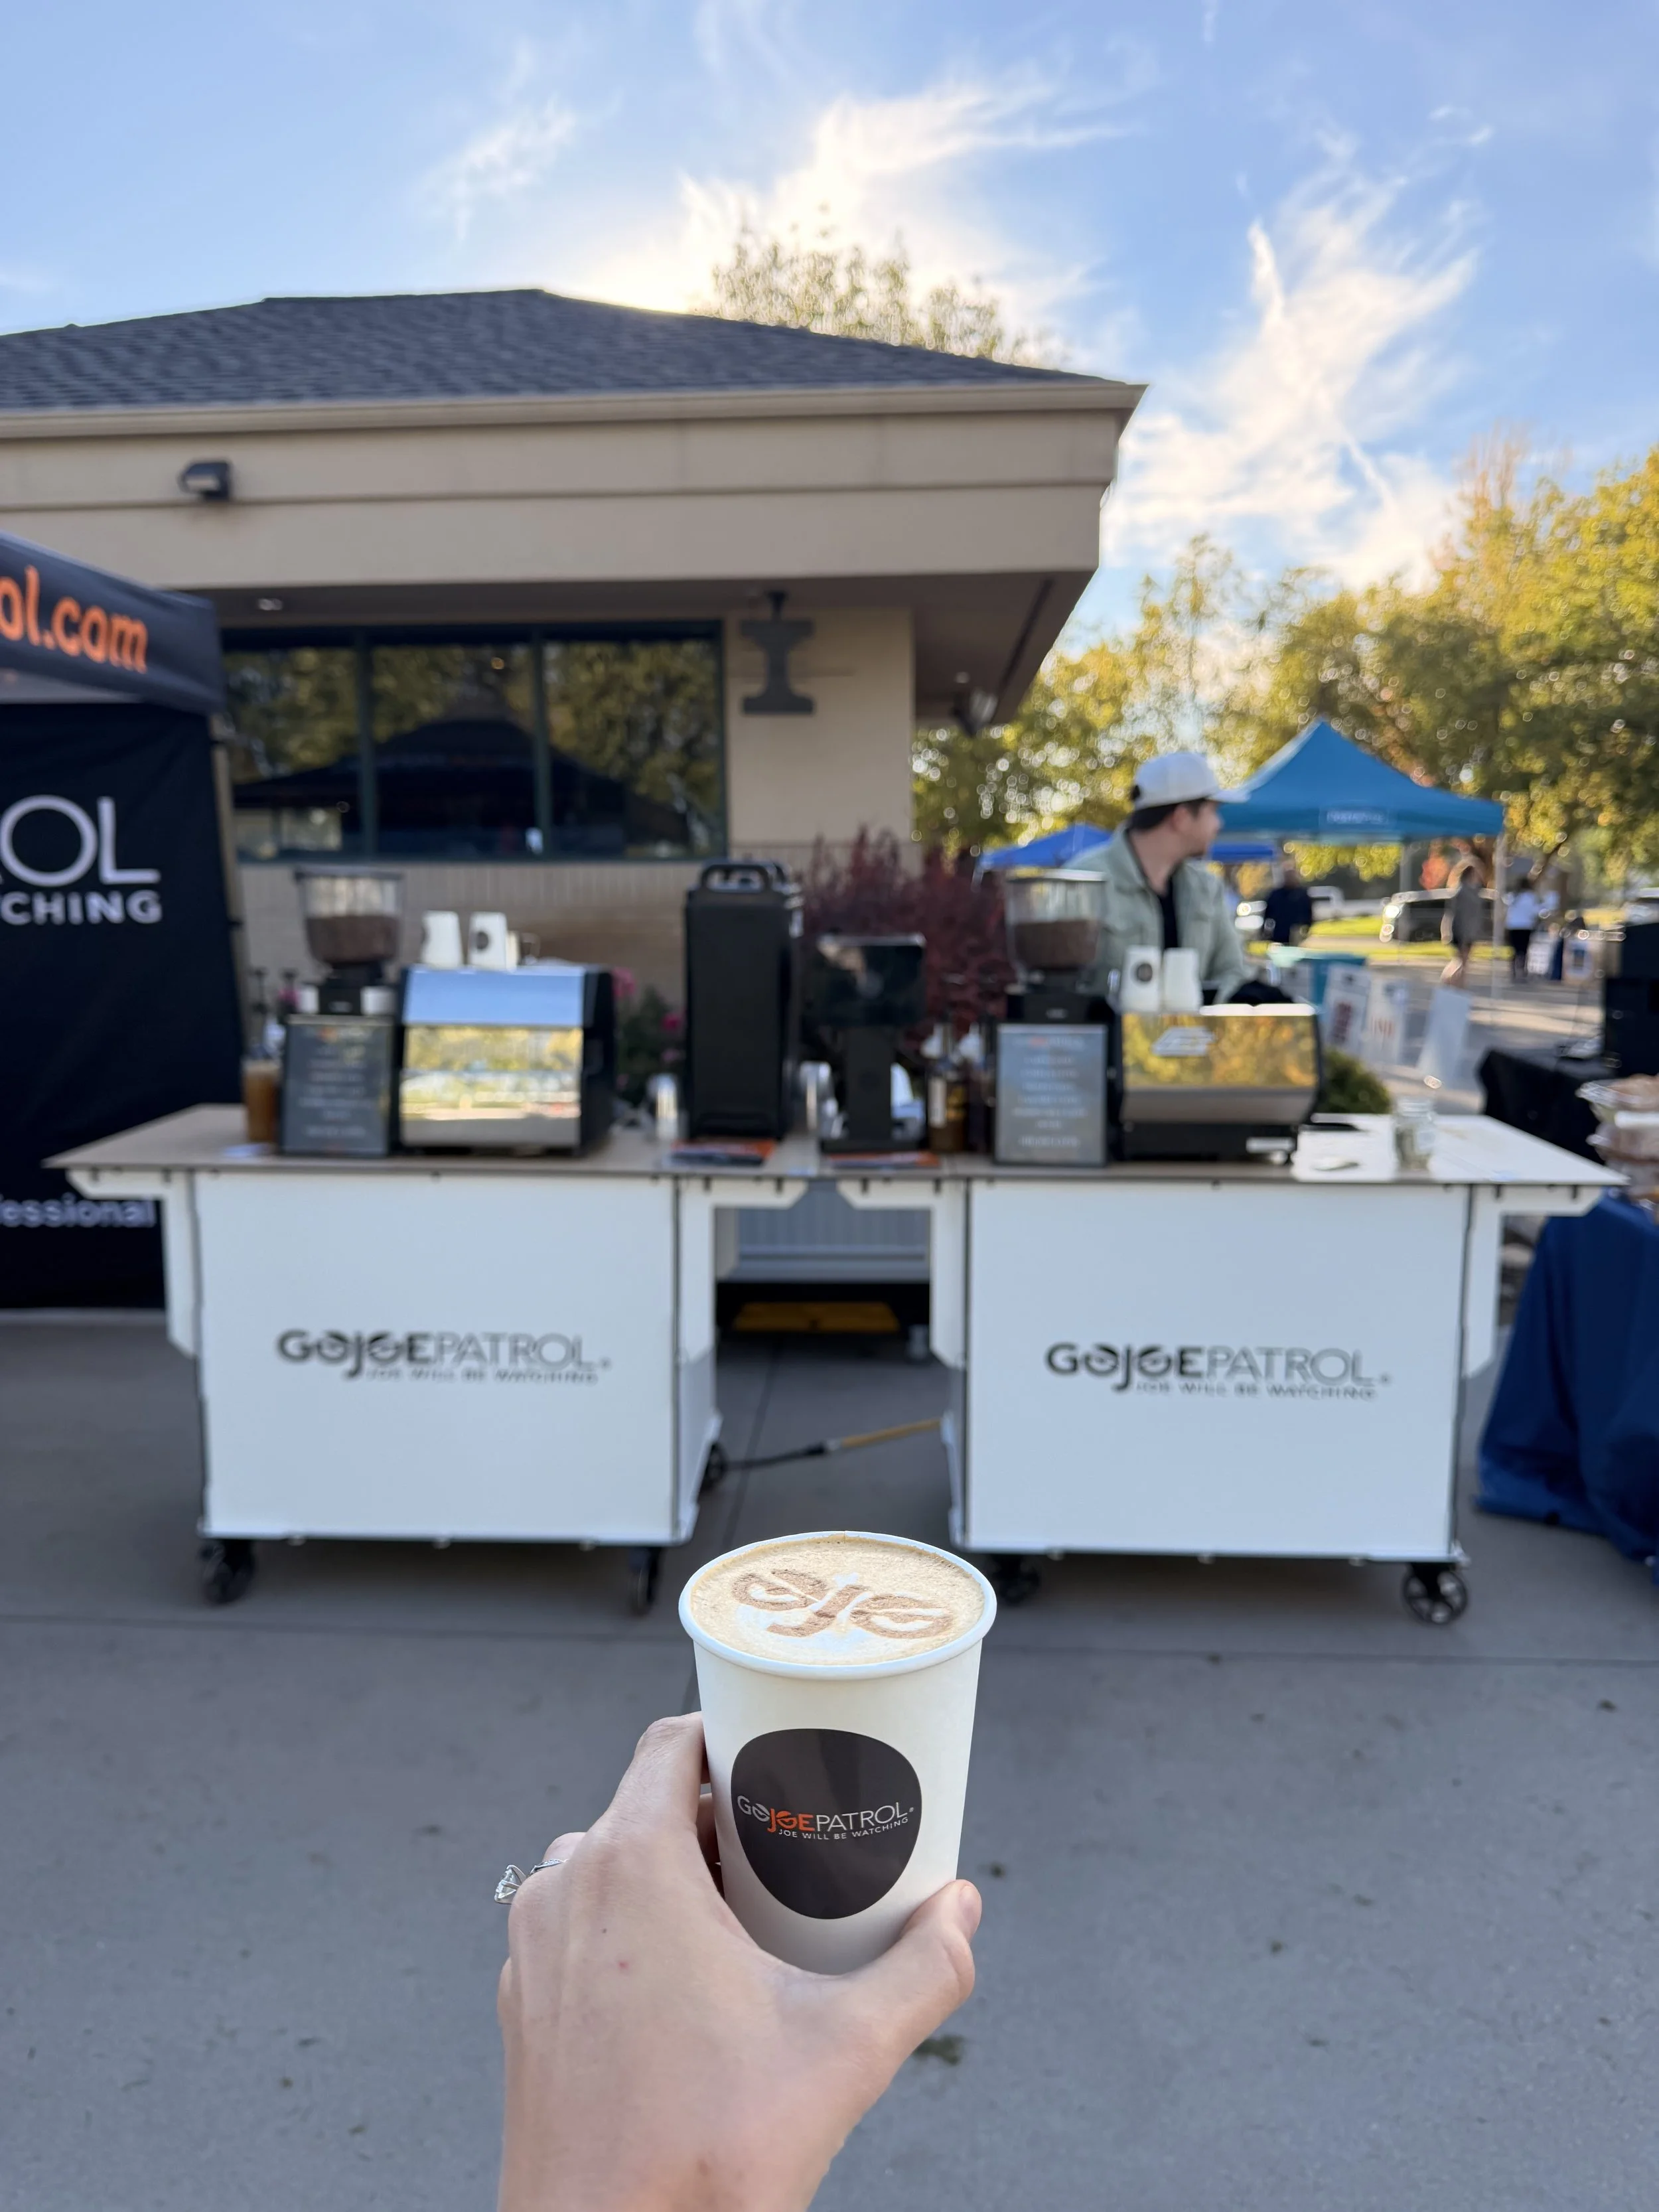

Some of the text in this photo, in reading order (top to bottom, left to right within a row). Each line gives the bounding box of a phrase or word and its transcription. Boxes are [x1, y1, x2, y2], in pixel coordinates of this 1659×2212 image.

[0, 890, 163, 925] CHING
[778, 1829, 798, 1838] JOE
[851, 1816, 908, 1837] WATCHING
